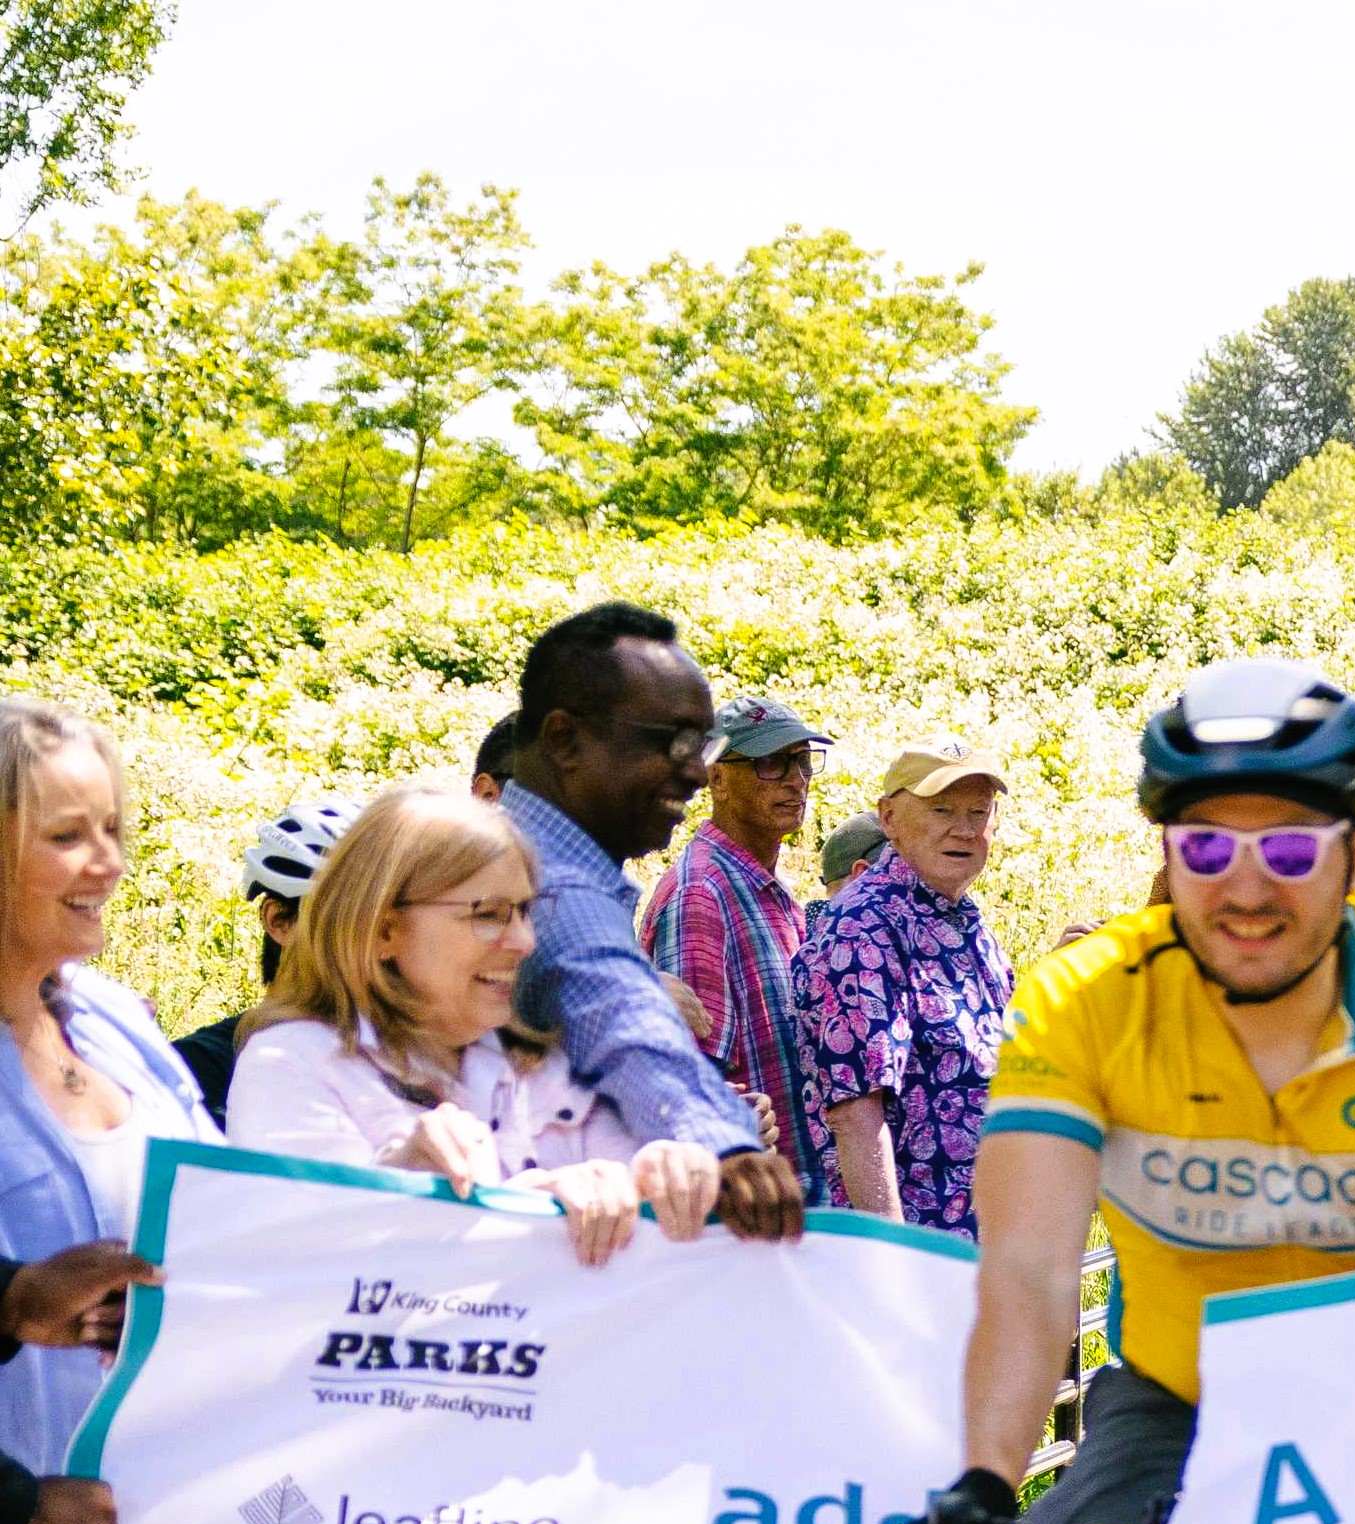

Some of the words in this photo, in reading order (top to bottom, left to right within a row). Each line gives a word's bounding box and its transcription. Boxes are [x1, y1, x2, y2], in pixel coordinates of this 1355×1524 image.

[390, 1292, 439, 1313] King
[442, 1296, 528, 1321] County
[315, 1331, 546, 1378] PARKS
[313, 1388, 375, 1404] Your
[380, 1388, 419, 1412] Big
[421, 1394, 532, 1421] Backyard
